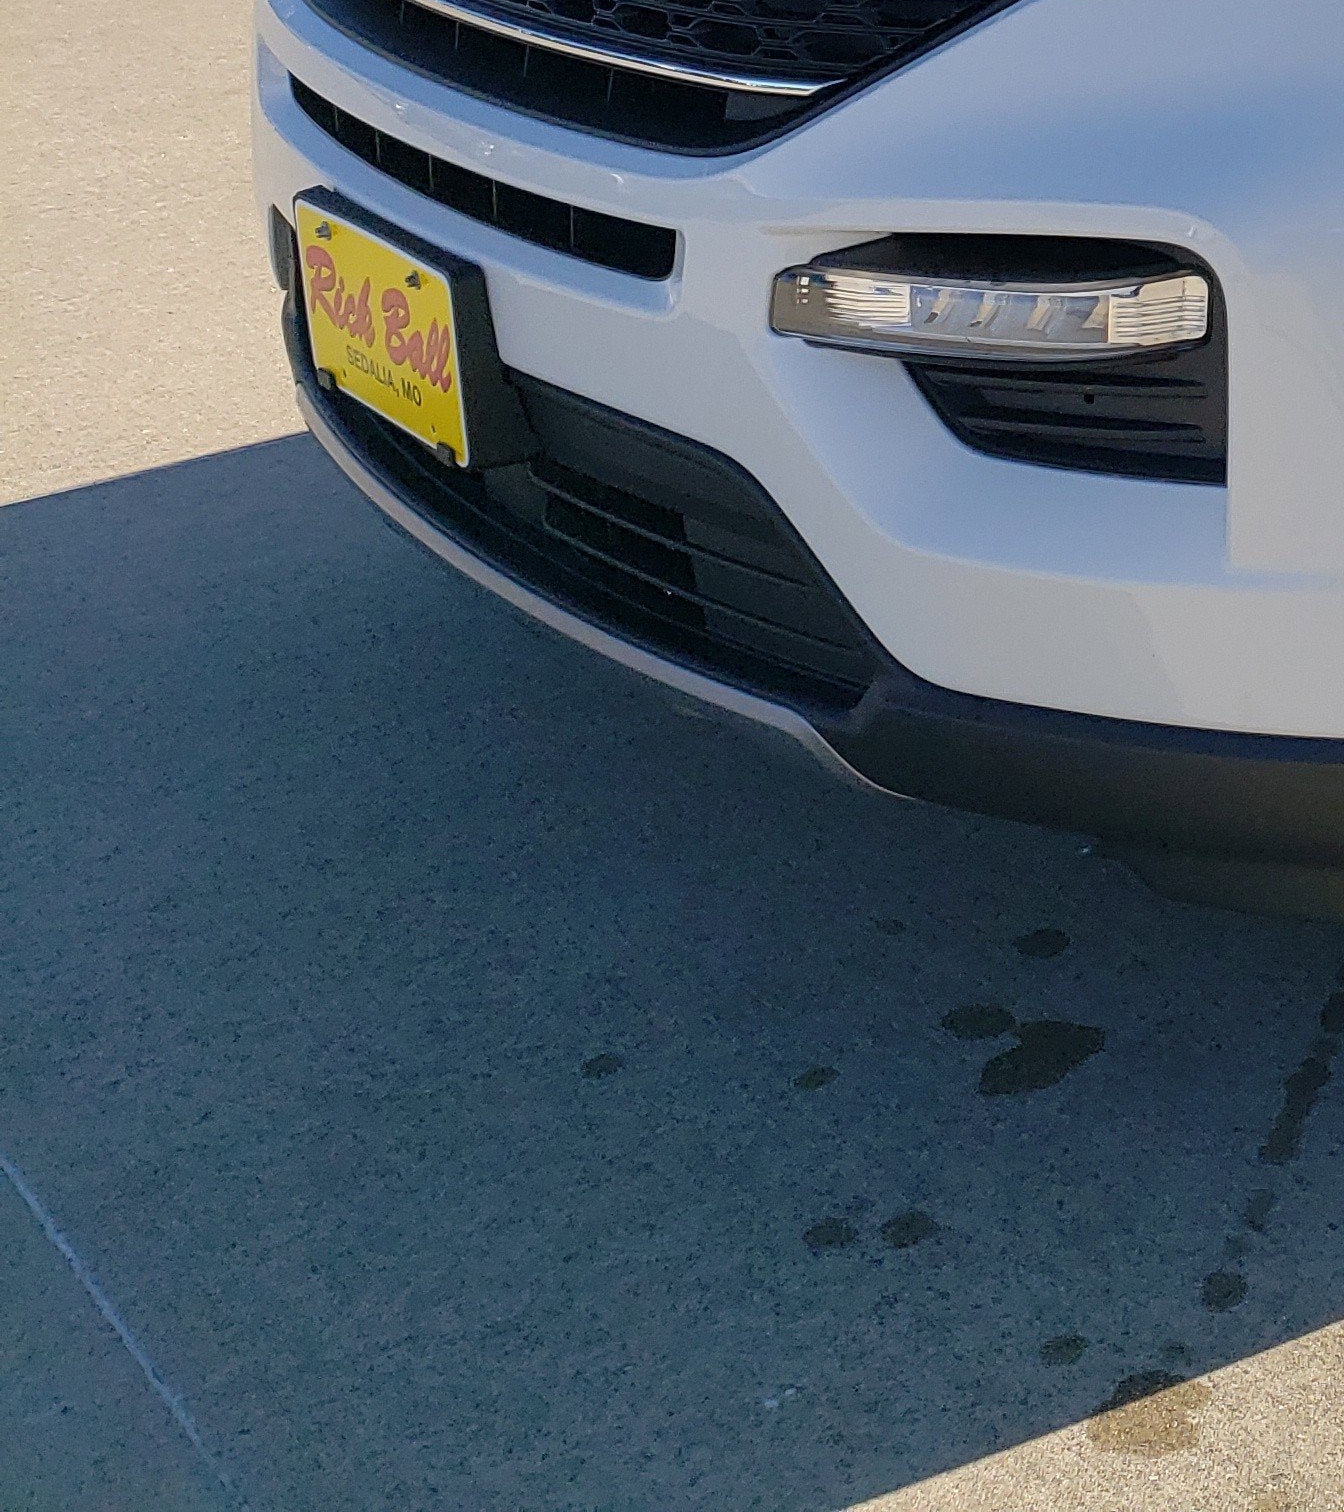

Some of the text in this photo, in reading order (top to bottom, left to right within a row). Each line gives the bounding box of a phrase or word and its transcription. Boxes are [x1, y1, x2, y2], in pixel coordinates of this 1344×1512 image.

[306, 245, 452, 394] Rich Ball
[345, 345, 423, 407] SEDALIA, MO
